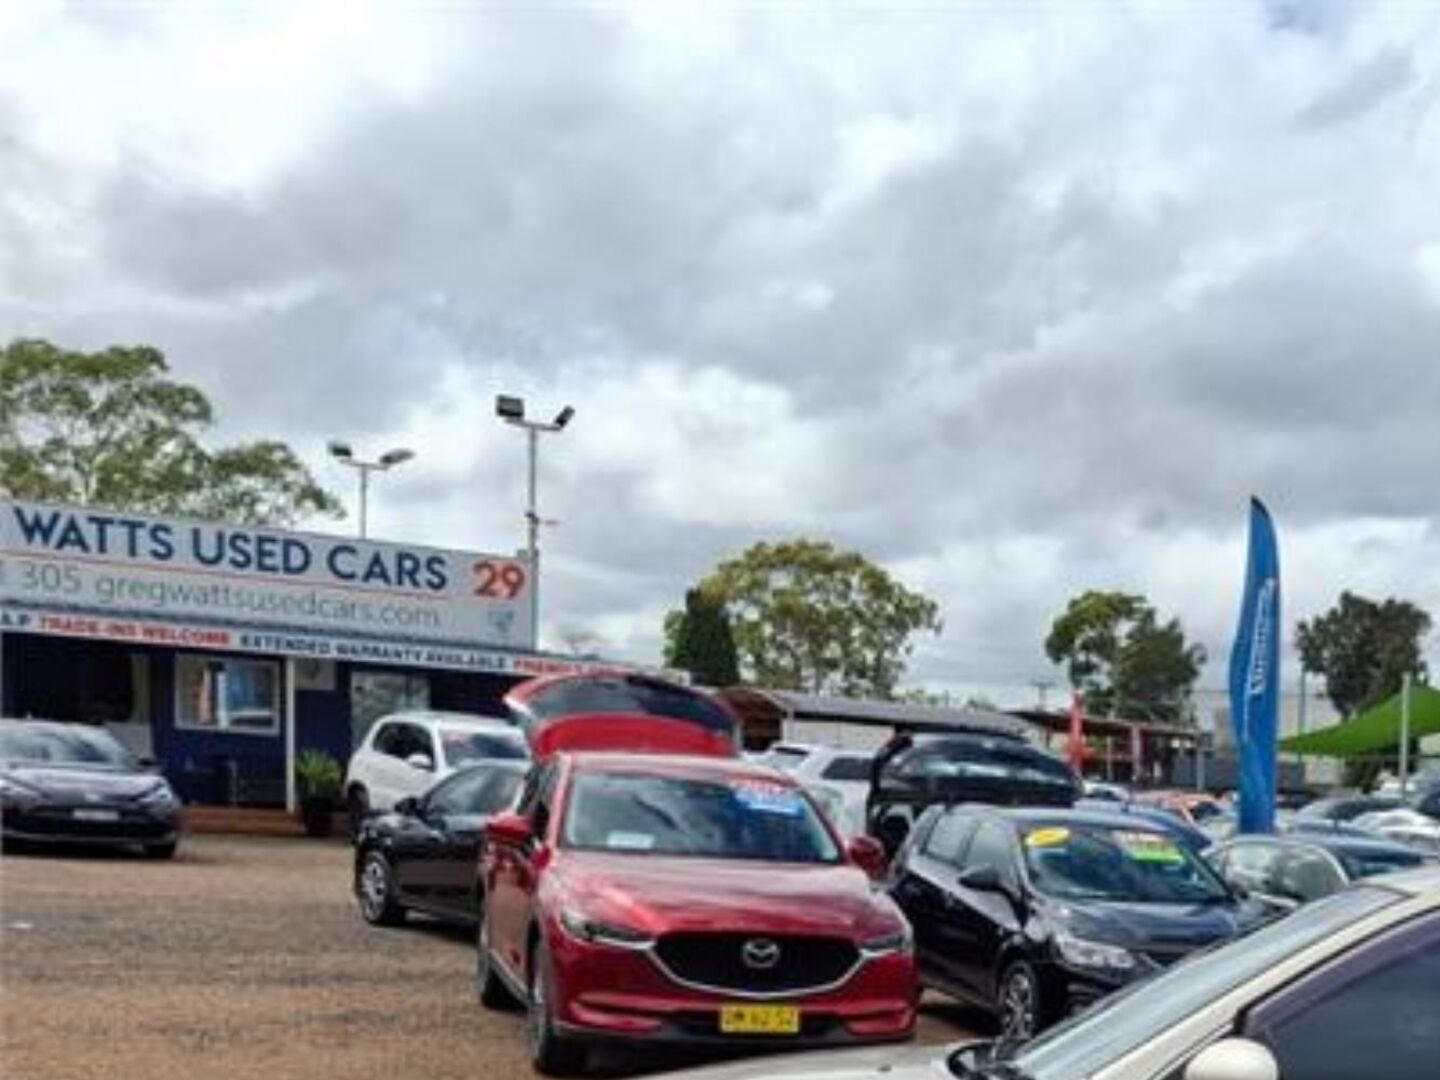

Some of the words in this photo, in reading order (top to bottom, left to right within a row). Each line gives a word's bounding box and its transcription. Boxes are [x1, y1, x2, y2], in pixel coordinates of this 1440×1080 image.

[14, 506, 174, 561] WATTS
[192, 527, 312, 575] USED
[327, 545, 448, 591] CARS
[473, 560, 525, 599] 29
[21, 561, 83, 594] 305
[142, 624, 230, 647] WELCOME
[240, 632, 332, 654] EXTENDED
